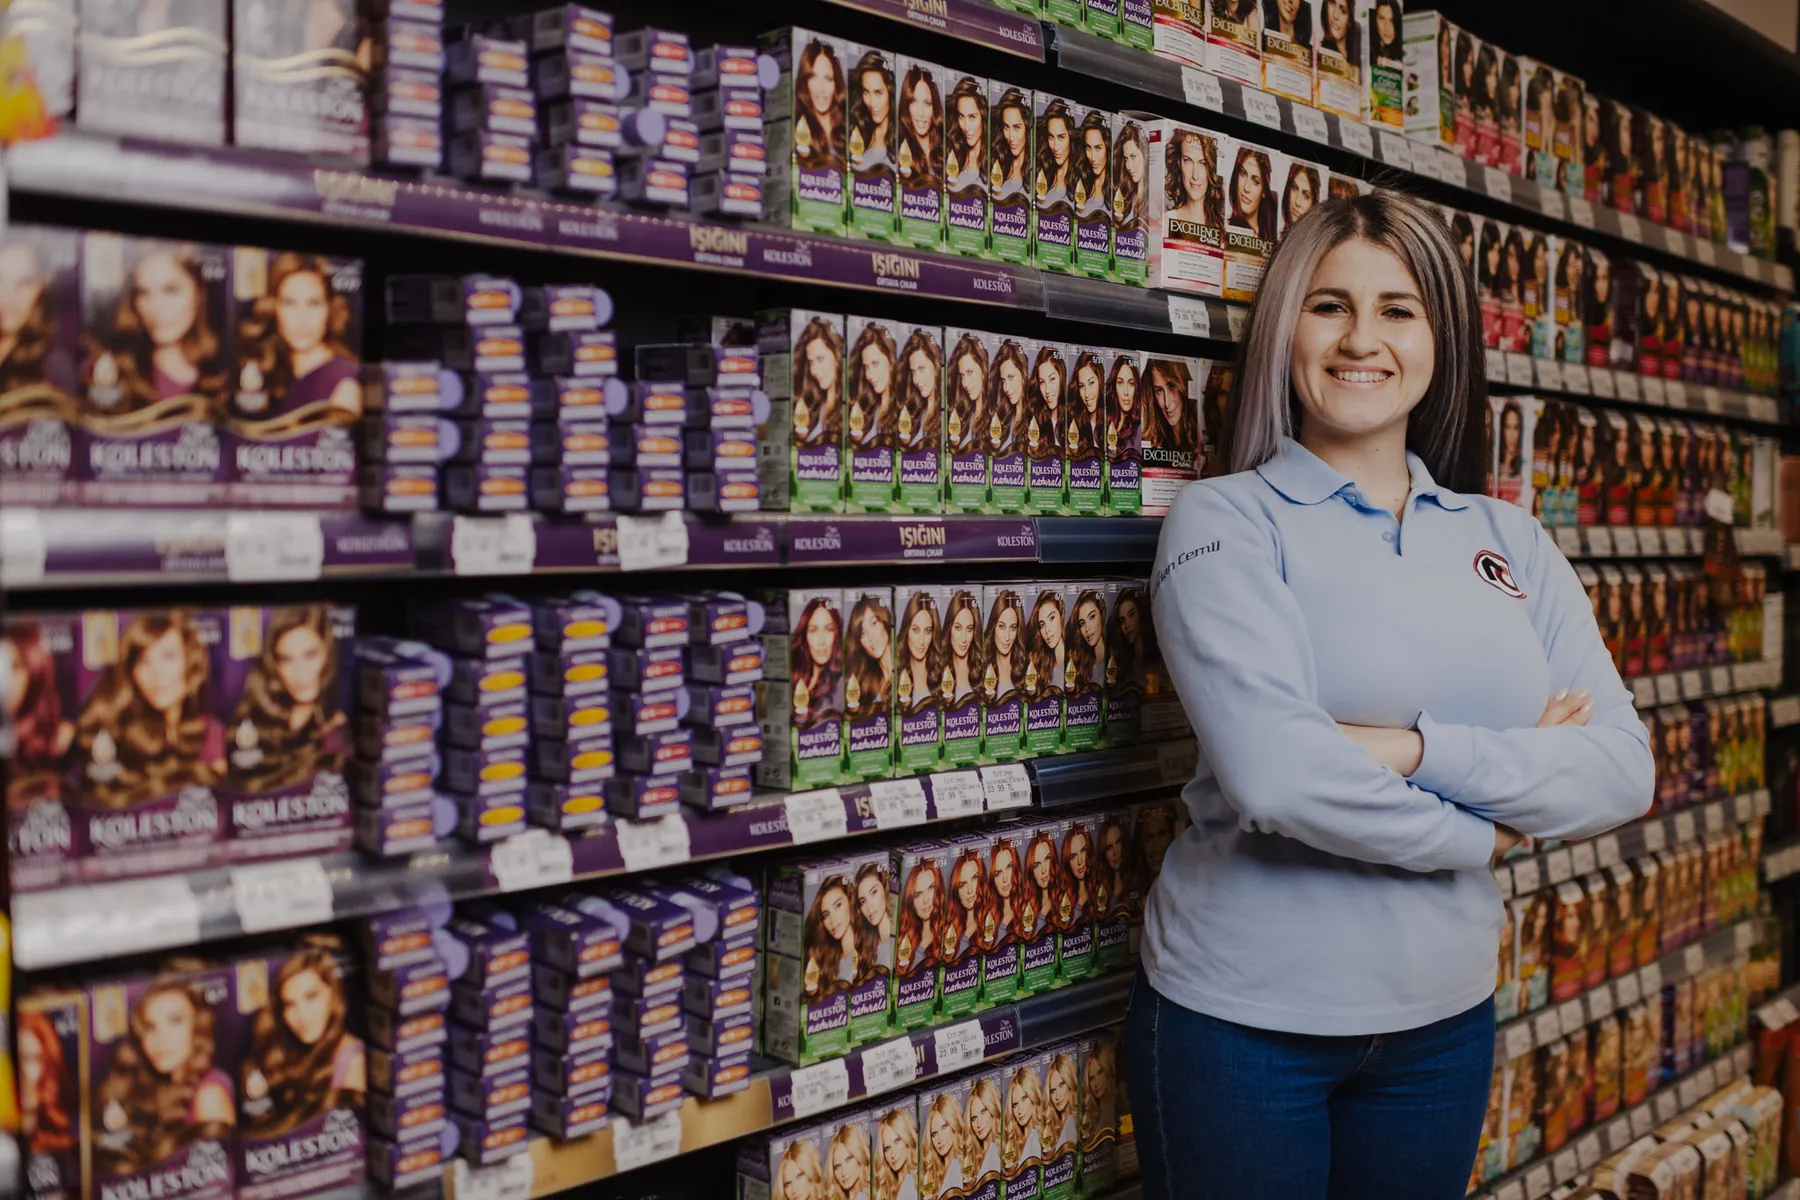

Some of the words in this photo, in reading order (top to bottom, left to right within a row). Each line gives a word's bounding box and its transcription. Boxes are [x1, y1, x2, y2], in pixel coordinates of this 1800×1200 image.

[1088, 1, 1116, 16] naturals
[1125, 3, 1150, 16] KOLESTON
[1124, 12, 1151, 28] naturals
[1000, 26, 1036, 46] KOLESTON
[856, 182, 892, 198] KOLESTON
[904, 194, 938, 208] KOLESTON
[903, 207, 940, 222] naturals
[950, 202, 983, 216] KOLESTON
[950, 215, 984, 230] naturals
[995, 212, 1026, 224] KOLESTON
[994, 222, 1026, 238] naturals
[1040, 219, 1070, 232] KOLESTON
[1170, 221, 1220, 240] EXCELLENCE
[1038, 231, 1070, 246] naturals
[1079, 228, 1108, 240] KOLESTON
[1078, 239, 1108, 252] naturals
[1117, 235, 1144, 248] KOLESTON
[1230, 234, 1274, 252] EXCELLENCE
[764, 248, 812, 268] KOLESTON
[1116, 247, 1146, 260] naturals
[973, 278, 1012, 293] KOLESTON
[1144, 449, 1192, 462] EXCELLENCE
[854, 457, 890, 468] KOLESTON
[903, 460, 936, 470] KOLESTON
[954, 461, 984, 472] KOLESTON
[994, 464, 1024, 474] KOLESTON
[854, 468, 892, 482] naturals
[902, 470, 937, 483] naturals
[1032, 466, 1061, 476] KOLESTON
[1072, 468, 1100, 477] KOLESTON
[1112, 468, 1138, 478] KOLESTON
[953, 472, 985, 484] naturals
[993, 474, 1024, 486] naturals
[1031, 476, 1062, 488] naturals
[1071, 478, 1100, 489] naturals
[1111, 478, 1138, 490] naturals
[724, 540, 774, 552] KOLESTON
[794, 538, 841, 550] KOLESTON
[997, 536, 1034, 547] KOLESTON
[1178, 540, 1220, 566] Cemil
[1030, 708, 1058, 718] KOLESTON
[1068, 704, 1098, 715] KOLESTON
[946, 716, 978, 728] KOLESTON
[988, 712, 1019, 723] KOLESTON
[1028, 718, 1060, 730] naturals
[1067, 714, 1098, 726] naturals
[852, 726, 887, 738] KOLESTON
[904, 720, 936, 732] KOLESTON
[986, 723, 1020, 736] naturals
[800, 732, 838, 746] KOLESTON
[902, 730, 938, 744] naturals
[946, 727, 980, 740] naturals
[851, 736, 888, 751] naturals
[750, 820, 791, 837] KOLESTO
[1064, 935, 1091, 948] KOLESTON
[1026, 944, 1054, 958] KOLESTON
[1063, 945, 1092, 958] naturals
[987, 954, 1016, 970] KOLESTON
[1025, 955, 1054, 970] naturals
[946, 966, 978, 982] KOLESTON
[986, 966, 1017, 980] naturals
[900, 980, 934, 994] KOLESTON
[944, 976, 978, 994] naturals
[900, 990, 934, 1006] naturals
[810, 1004, 846, 1021] KOLESTON
[808, 1016, 847, 1034] naturals
[984, 1029, 1014, 1046] OLESTON
[1046, 1161, 1072, 1178] KOLESTON
[1008, 1176, 1036, 1194] KOLESTON
[1044, 1170, 1074, 1188] naturals
